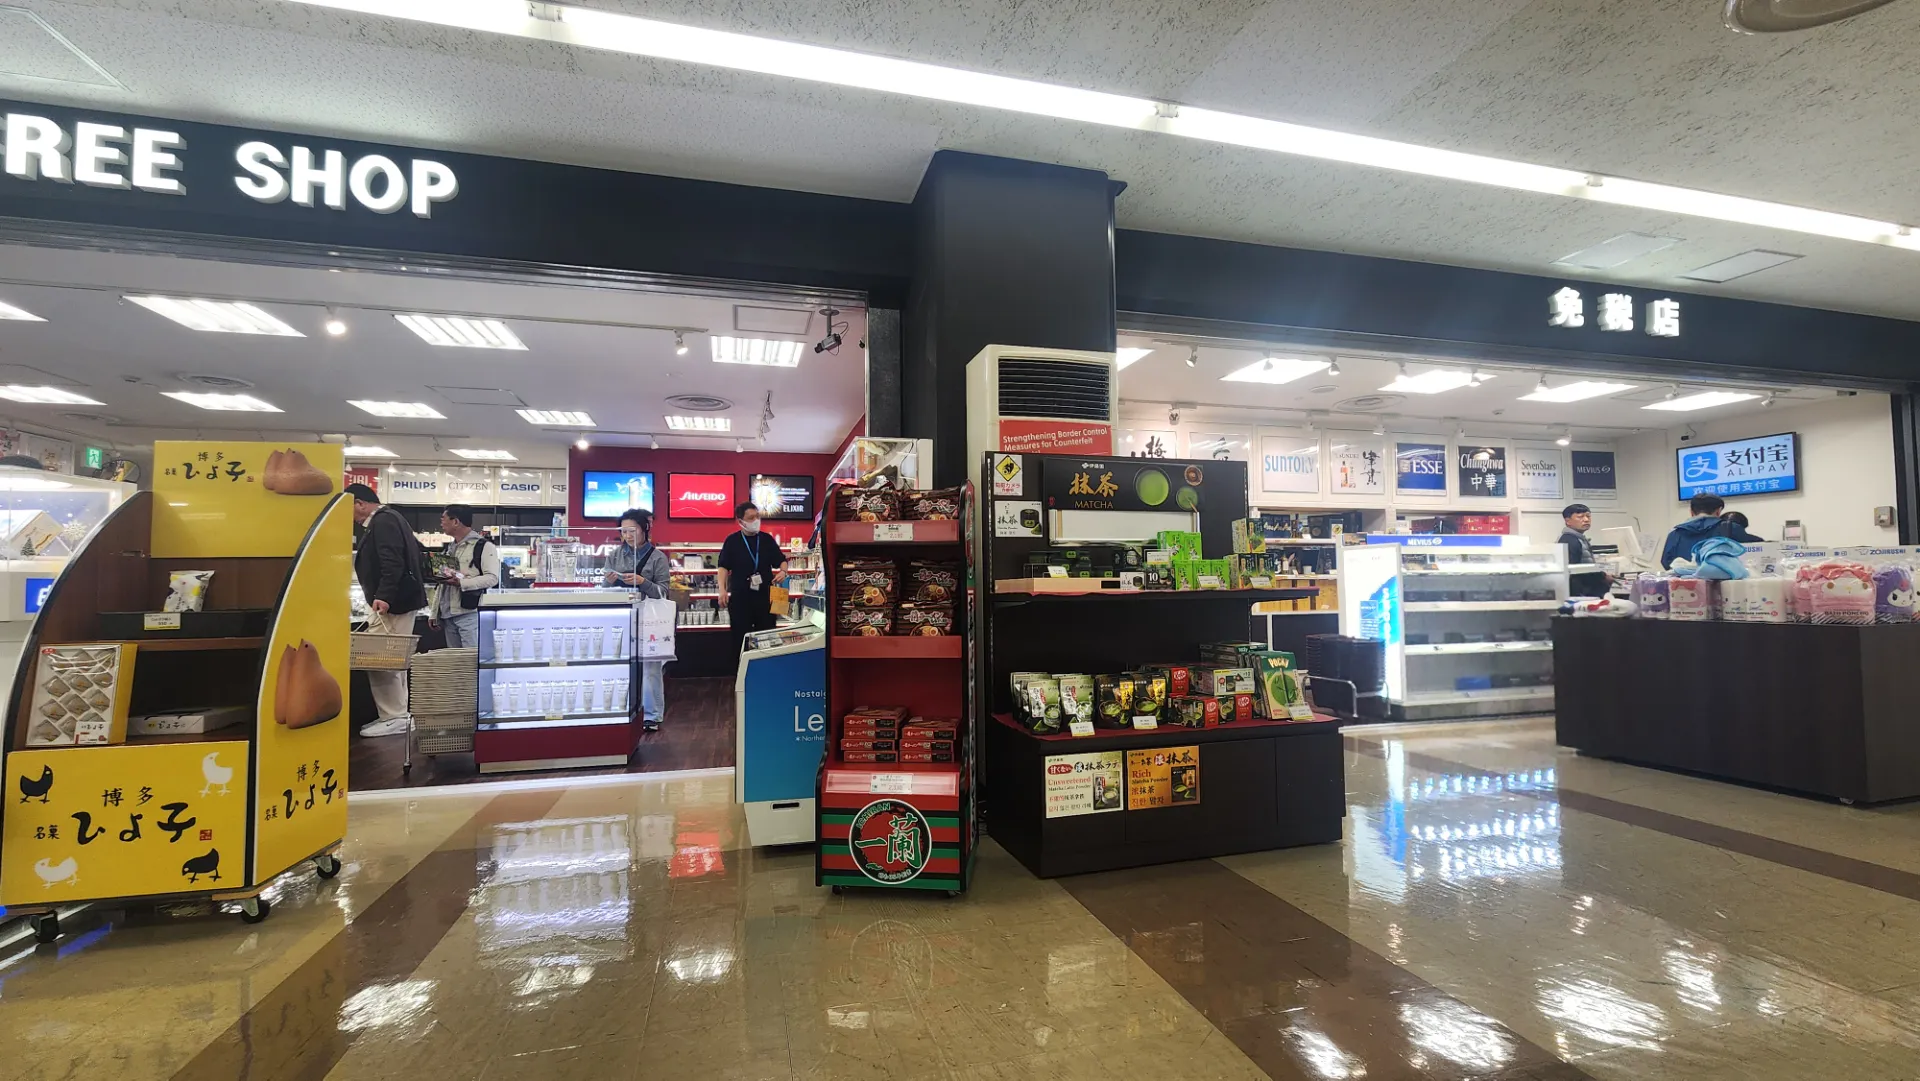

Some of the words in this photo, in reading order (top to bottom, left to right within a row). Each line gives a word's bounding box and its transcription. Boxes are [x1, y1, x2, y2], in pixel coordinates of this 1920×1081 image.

[0, 112, 188, 196] REE
[234, 140, 460, 219] SHOP
[1547, 286, 1680, 337] 免税店
[1002, 432, 1056, 443] Strengthening
[1058, 429, 1081, 438] Border
[1083, 427, 1107, 436] Control
[1004, 442, 1040, 452] Measures
[1041, 441, 1052, 449] for
[1053, 437, 1093, 447] Counterfeit
[197, 451, 224, 462] 博多
[1460, 453, 1504, 473] Chunghwa
[1723, 443, 1789, 468] 支付宝
[182, 461, 246, 482] ひよ子
[1412, 460, 1443, 475] ESSE
[1576, 466, 1600, 474] MEVIUS
[1726, 463, 1788, 477] ALIPAY
[393, 480, 437, 490] PHILIPS
[448, 481, 489, 491] CITIZEN
[500, 483, 540, 492] CASIO
[1068, 471, 1119, 498] 抹茶
[1471, 473, 1497, 491] 中華
[1692, 479, 1781, 496] 欢迎使用支付宝
[679, 491, 726, 501] SHISEIDO
[783, 504, 804, 513] ELIXIR
[1074, 500, 1114, 509] MATCHA
[1407, 538, 1432, 546] MEVIUS
[1869, 548, 1906, 556] ZOJIRUSHI
[1147, 572, 1159, 582] 10
[296, 760, 321, 783] 博多
[1132, 769, 1151, 779] Rich
[1048, 776, 1092, 786] Unsweetened
[101, 785, 154, 808] 博多
[282, 768, 338, 820] ひよ子
[856, 802, 891, 829] ICHIRAN
[33, 824, 60, 840] 名菓
[71, 802, 197, 846] ひよ子
[854, 811, 922, 869] 一蘭
